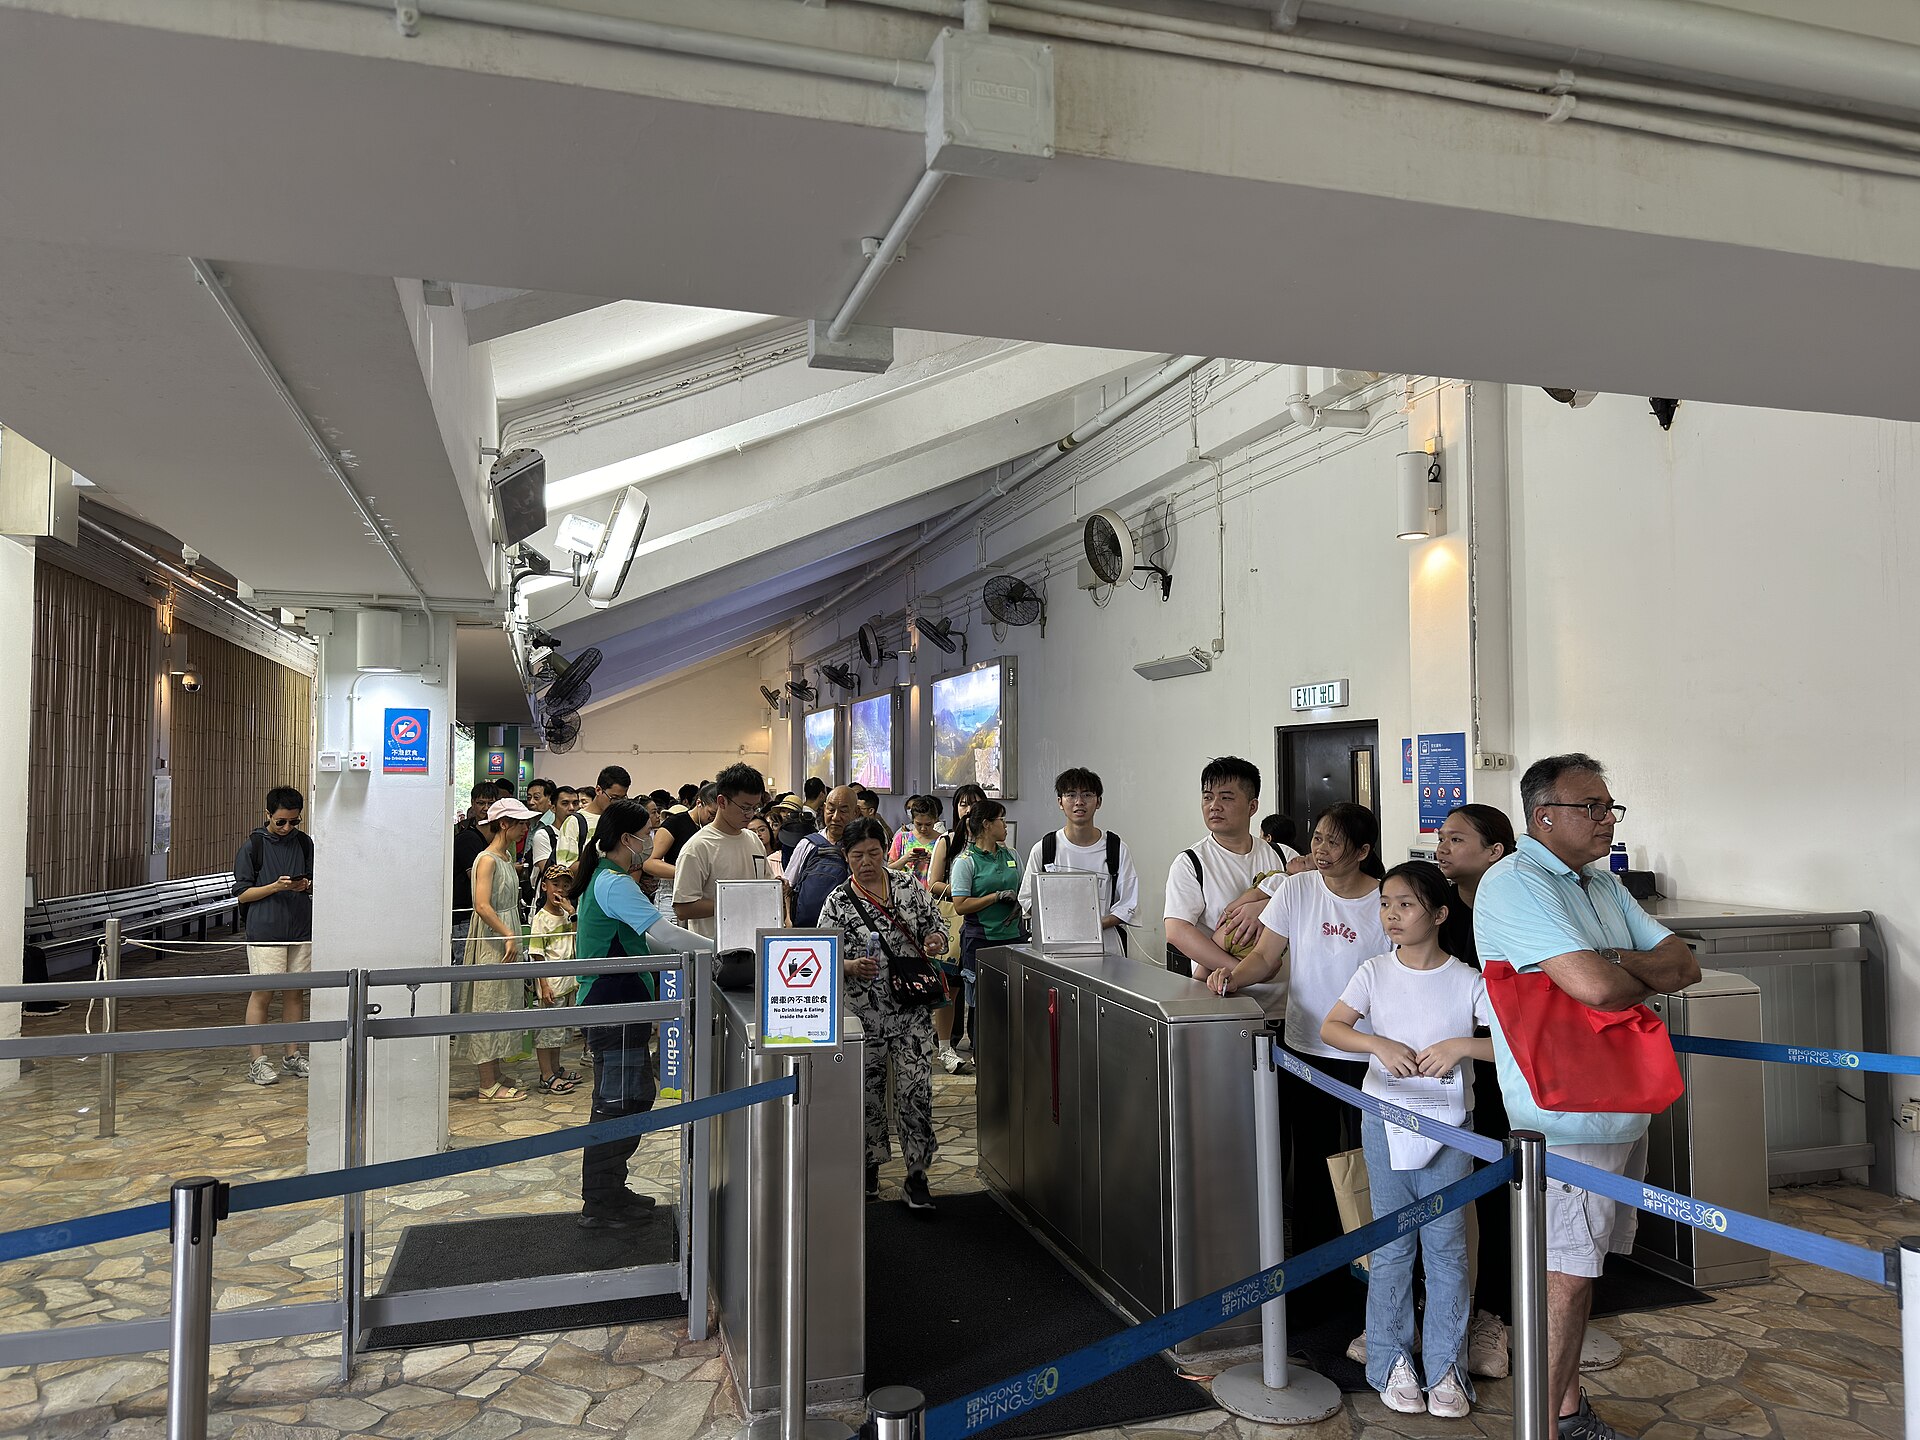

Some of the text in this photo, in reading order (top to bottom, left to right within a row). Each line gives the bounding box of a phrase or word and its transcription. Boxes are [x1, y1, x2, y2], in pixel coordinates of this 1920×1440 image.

[1297, 685, 1334, 706] EXIT 出口
[667, 1027, 679, 1076] Cabin
[1798, 1049, 1829, 1058] NGONG
[1798, 1052, 1860, 1068] PING 360
[1653, 1191, 1691, 1210] NGONG
[1654, 1200, 1728, 1233] PING 360
[1230, 1269, 1285, 1313] PING 360
[1231, 1279, 1260, 1298] NGONG
[979, 1367, 1059, 1425] PING 360
[980, 1381, 1022, 1406] NGONG
